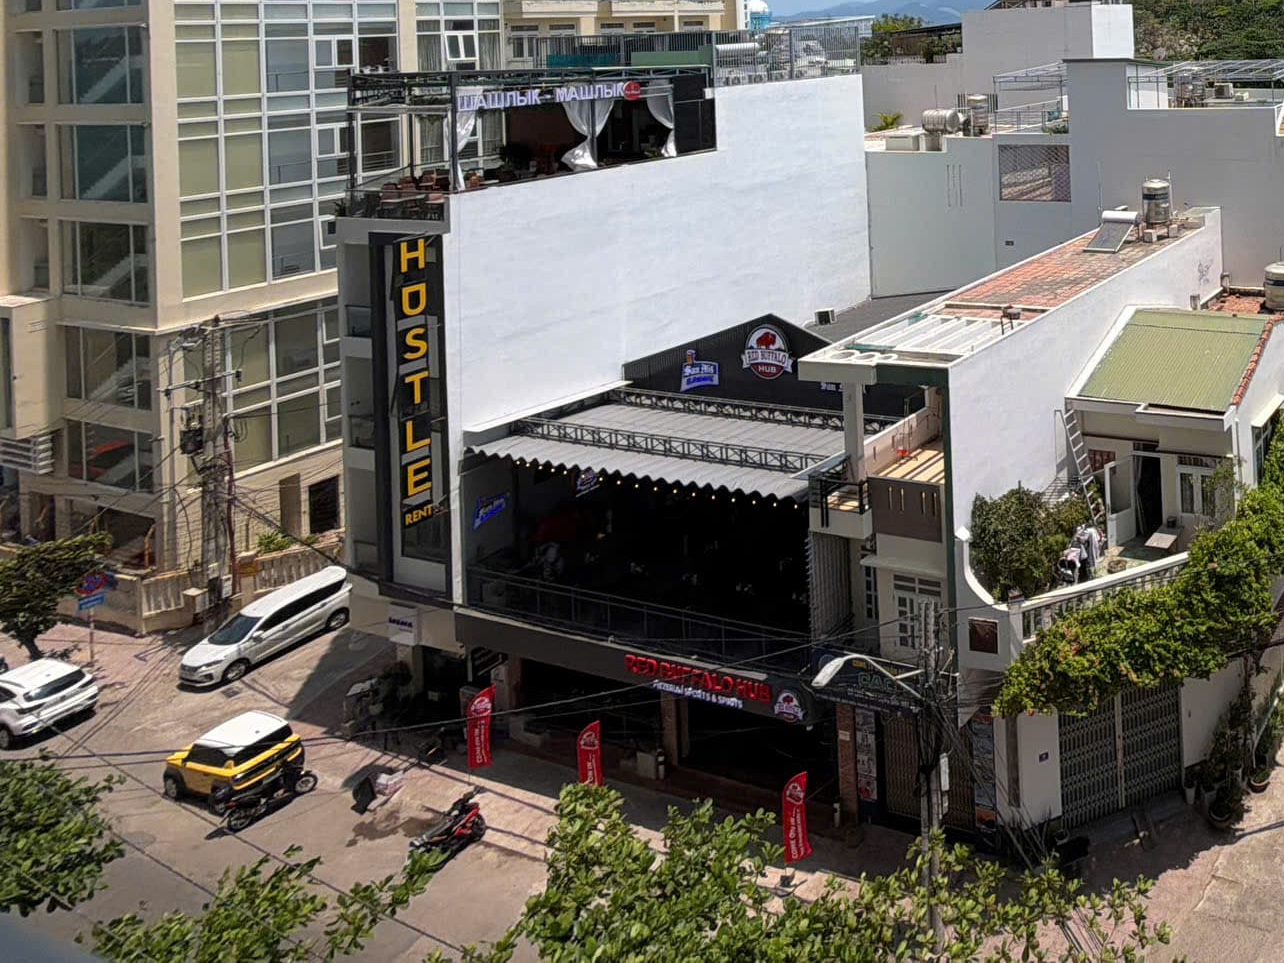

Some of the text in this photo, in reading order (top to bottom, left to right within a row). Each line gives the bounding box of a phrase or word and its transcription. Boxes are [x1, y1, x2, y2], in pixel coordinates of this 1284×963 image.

[758, 365, 777, 373] HUB
[405, 504, 433, 526] RENT
[624, 654, 658, 677] RED
[737, 678, 772, 703] HUB
